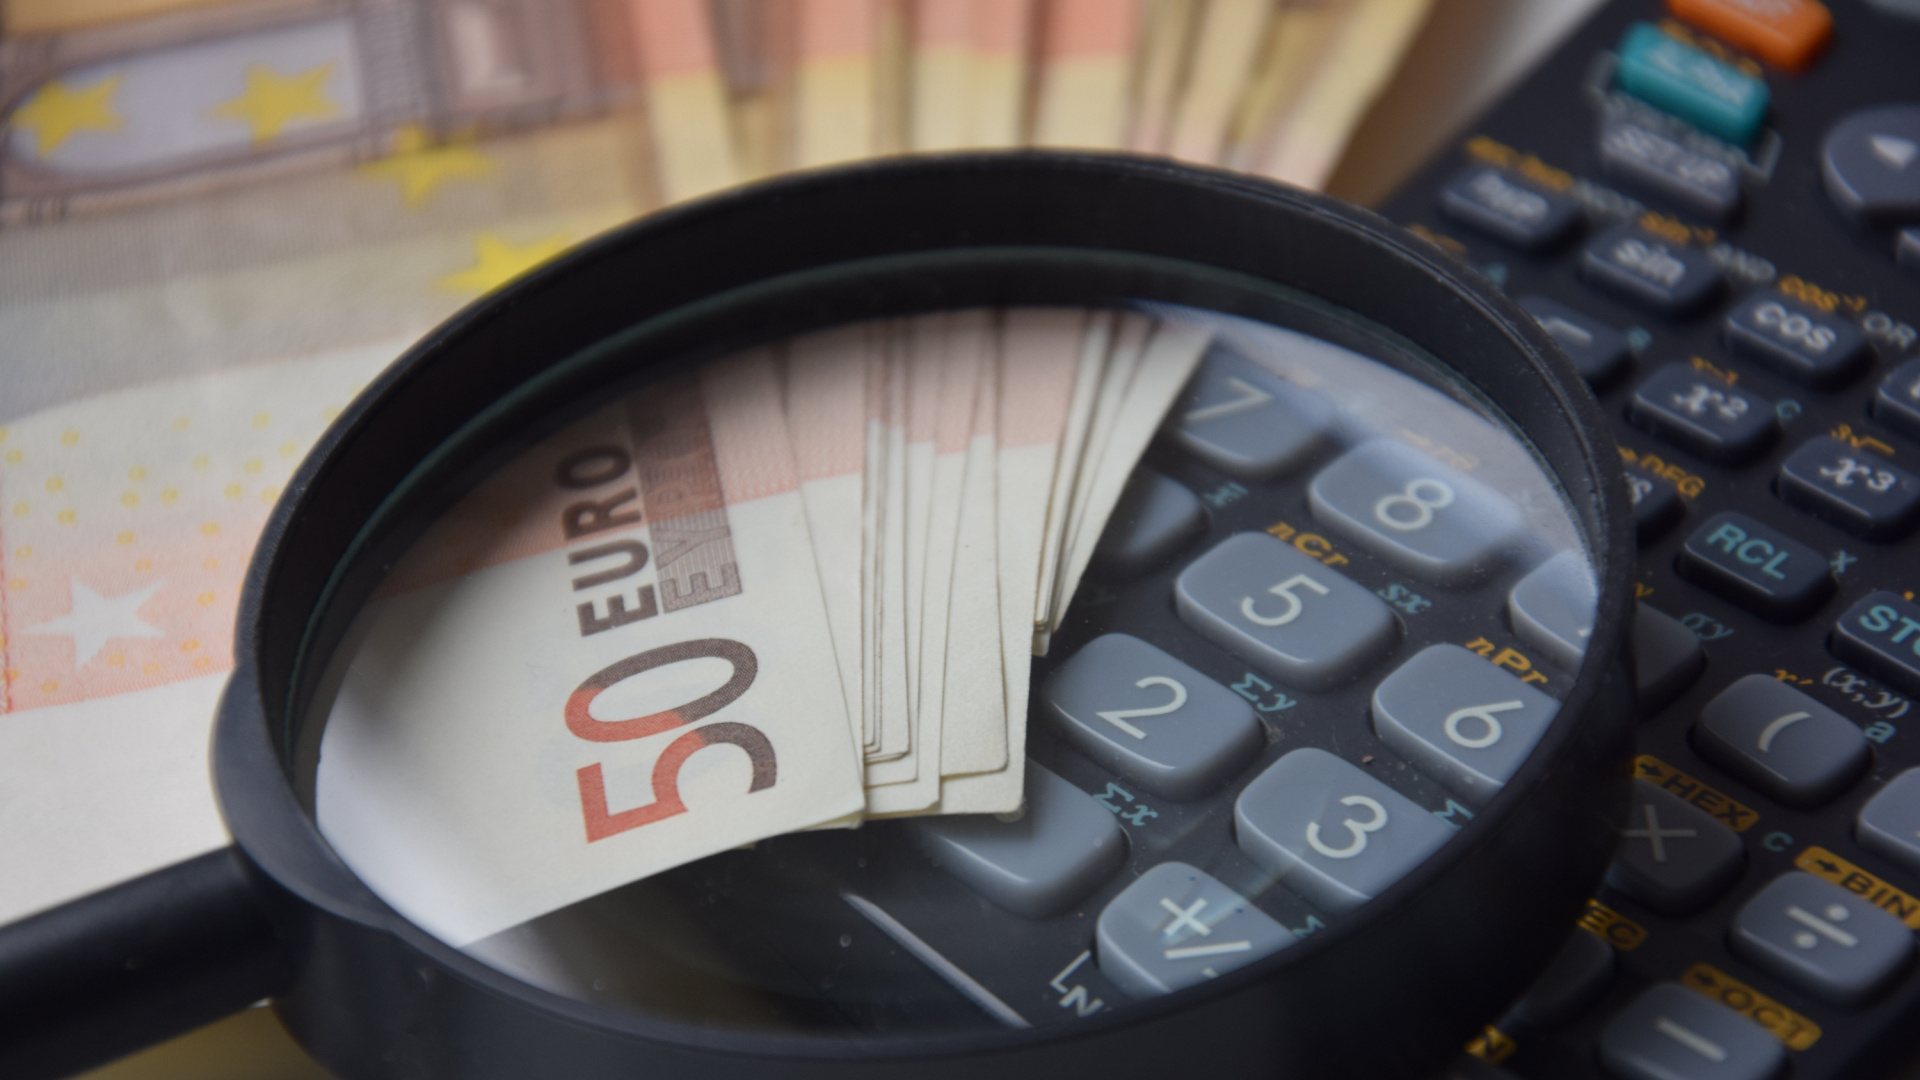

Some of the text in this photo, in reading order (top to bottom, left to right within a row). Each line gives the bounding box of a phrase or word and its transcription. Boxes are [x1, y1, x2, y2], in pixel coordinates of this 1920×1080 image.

[1614, 238, 1686, 286] sin
[1754, 301, 1838, 352] cos
[1862, 311, 1918, 349] OR
[1184, 376, 1272, 422] 7
[1374, 476, 1455, 532] 8
[1264, 520, 1350, 567] nCr
[1706, 521, 1789, 581] RCL
[1240, 572, 1331, 628] 5
[554, 445, 777, 844] 50 EURO
[1464, 635, 1549, 686] nPr
[1095, 675, 1189, 741] 2
[1443, 699, 1526, 750] 6
[1305, 794, 1390, 860] 3
[1661, 771, 1751, 830] HEX
[1841, 871, 1920, 918] BIN
[1720, 985, 1813, 1045] OCT
